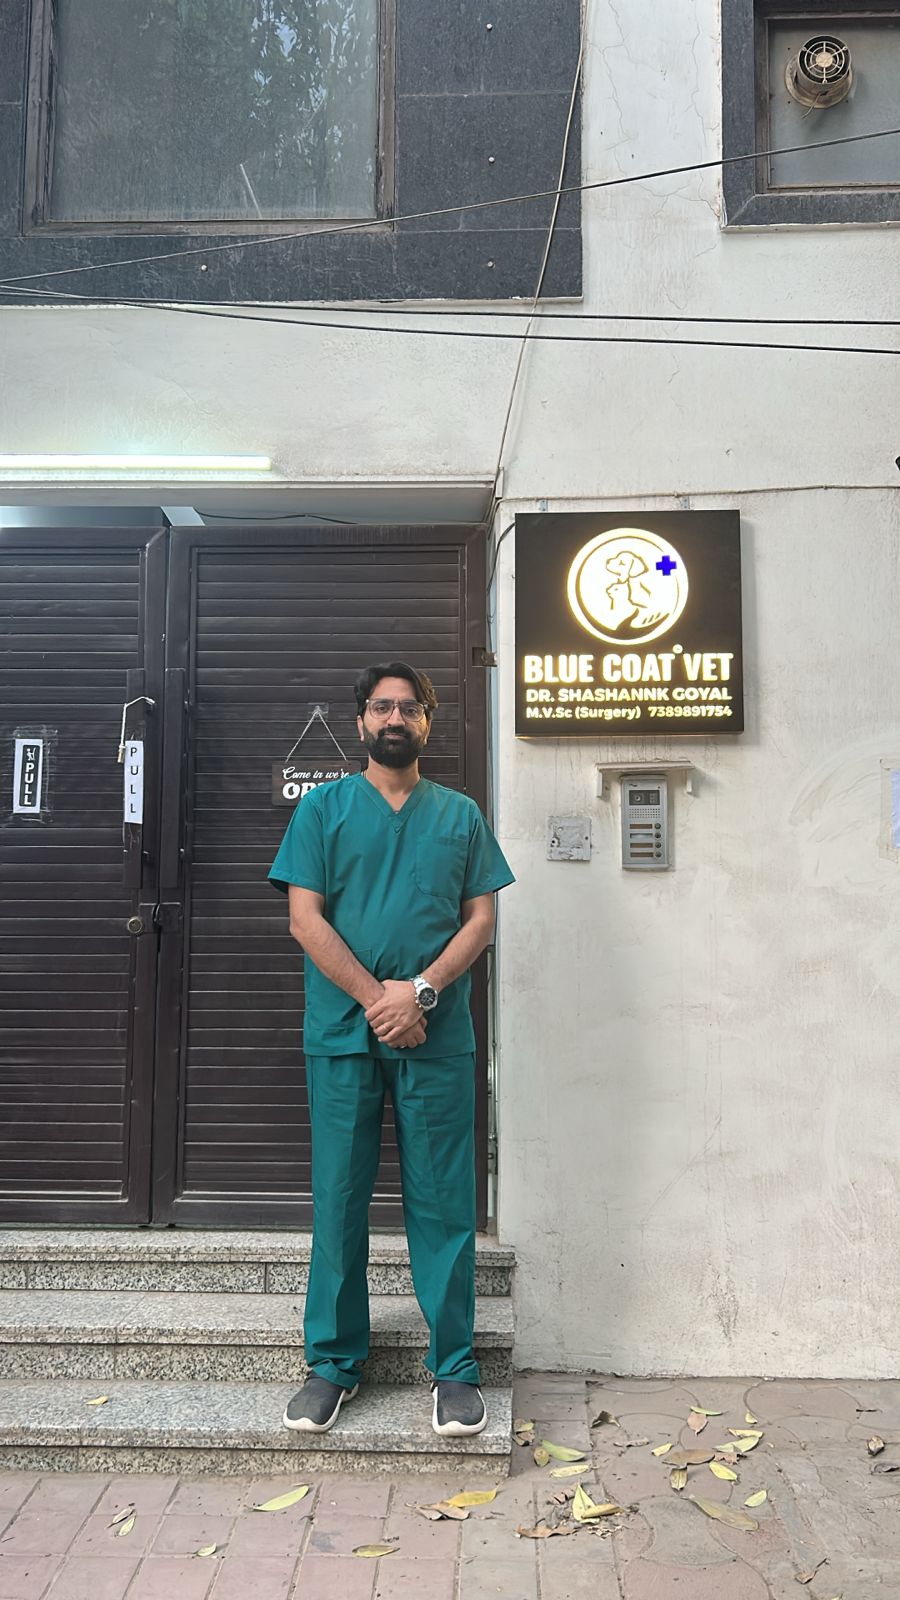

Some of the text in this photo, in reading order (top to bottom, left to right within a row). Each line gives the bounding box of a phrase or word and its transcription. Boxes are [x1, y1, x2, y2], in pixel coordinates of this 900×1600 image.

[523, 652, 734, 684] BLUE COAT VET
[525, 686, 733, 703] DR. SHASHANNK GOYAL
[525, 705, 733, 720] M.V.Sc (Surgery) 7389891754
[130, 747, 139, 813] PULL
[282, 766, 311, 780] Come
[312, 770, 324, 780] in
[24, 762, 35, 805] PULL
[282, 782, 325, 800] OP
